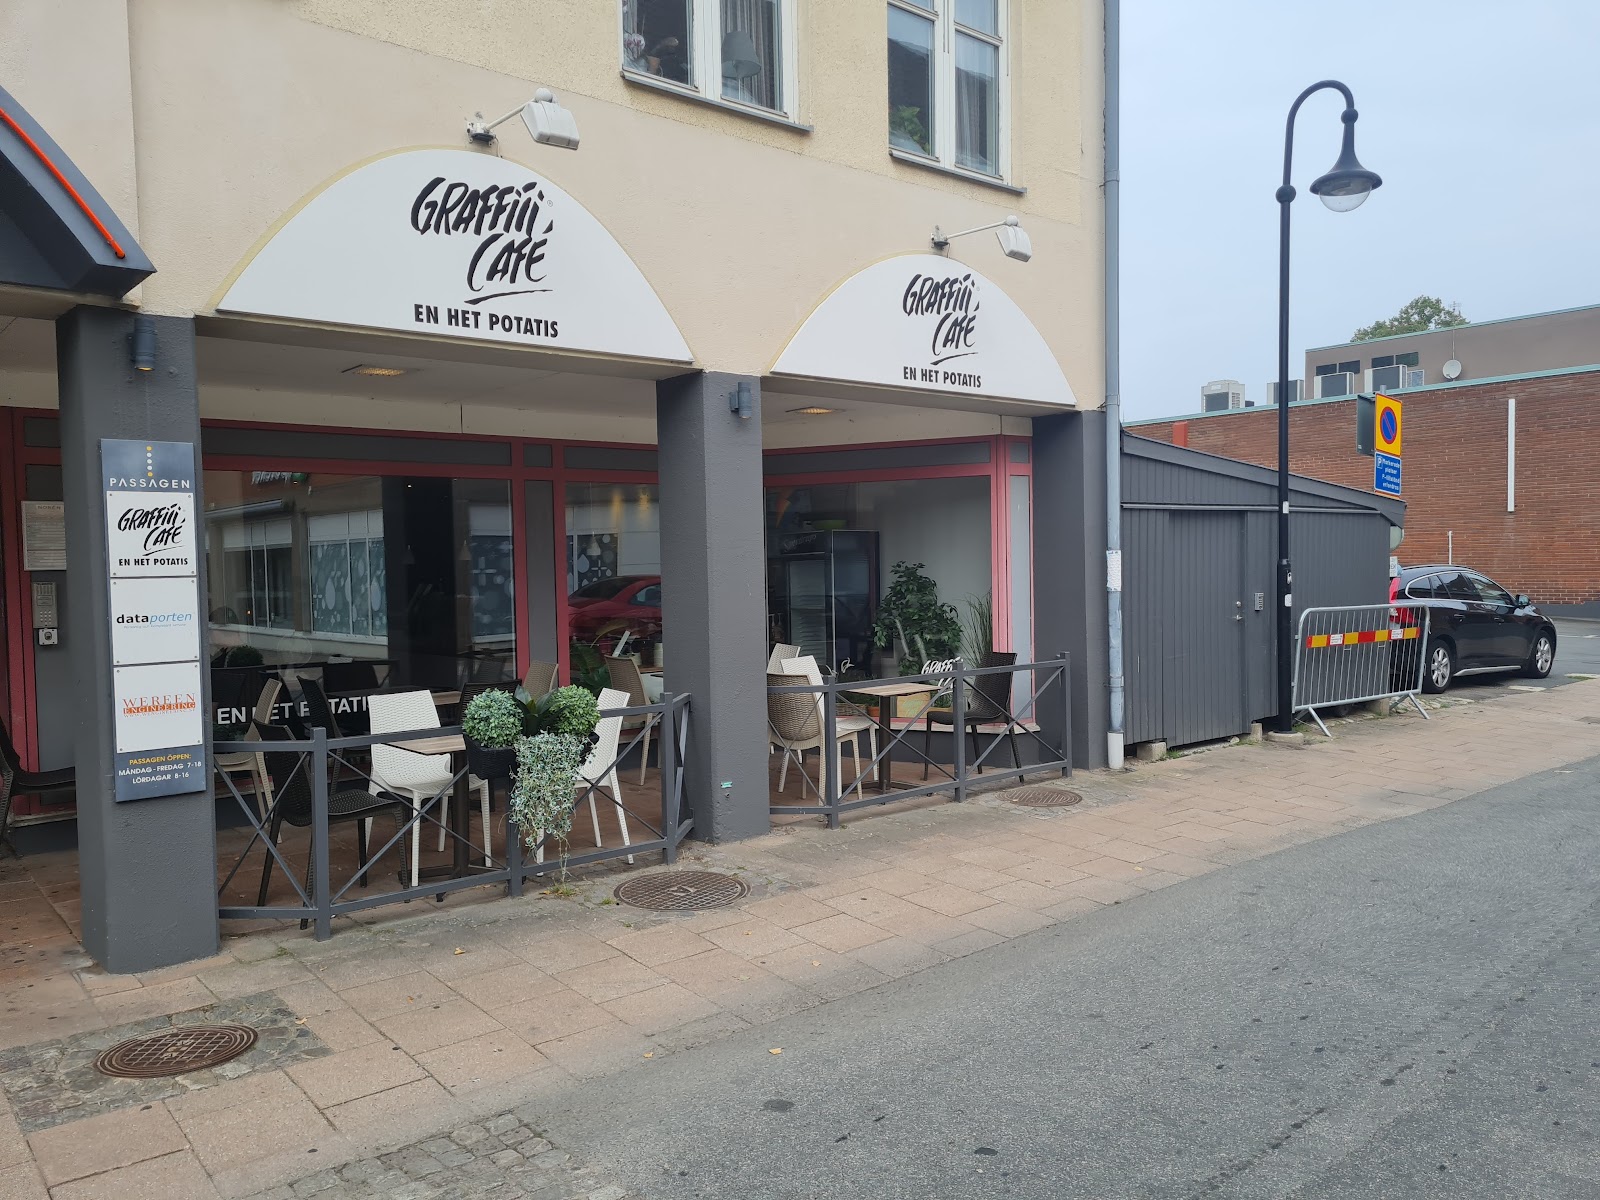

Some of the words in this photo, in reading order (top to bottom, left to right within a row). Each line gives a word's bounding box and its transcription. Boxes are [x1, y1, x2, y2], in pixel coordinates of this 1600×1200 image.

[414, 303, 439, 325] EN
[447, 307, 481, 330] HET
[488, 312, 559, 339] POTATIS
[903, 366, 917, 381] EN
[921, 368, 940, 383] HET
[943, 371, 982, 388] POTATIS
[109, 477, 190, 489] PASSAGEN
[118, 558, 131, 567] EN
[134, 558, 150, 566] HET
[153, 557, 188, 566] POTATIS
[116, 612, 192, 625] dataporten
[122, 693, 196, 708] WEREEN
[123, 701, 196, 714] ENGINEERING
[217, 707, 246, 725] EN
[129, 755, 166, 766] PASSAGEN
[167, 753, 191, 762] ÖPPEN:
[187, 761, 201, 769] 7-18
[132, 774, 171, 784] LÖRDAGAR
[174, 772, 190, 780] 8-16
